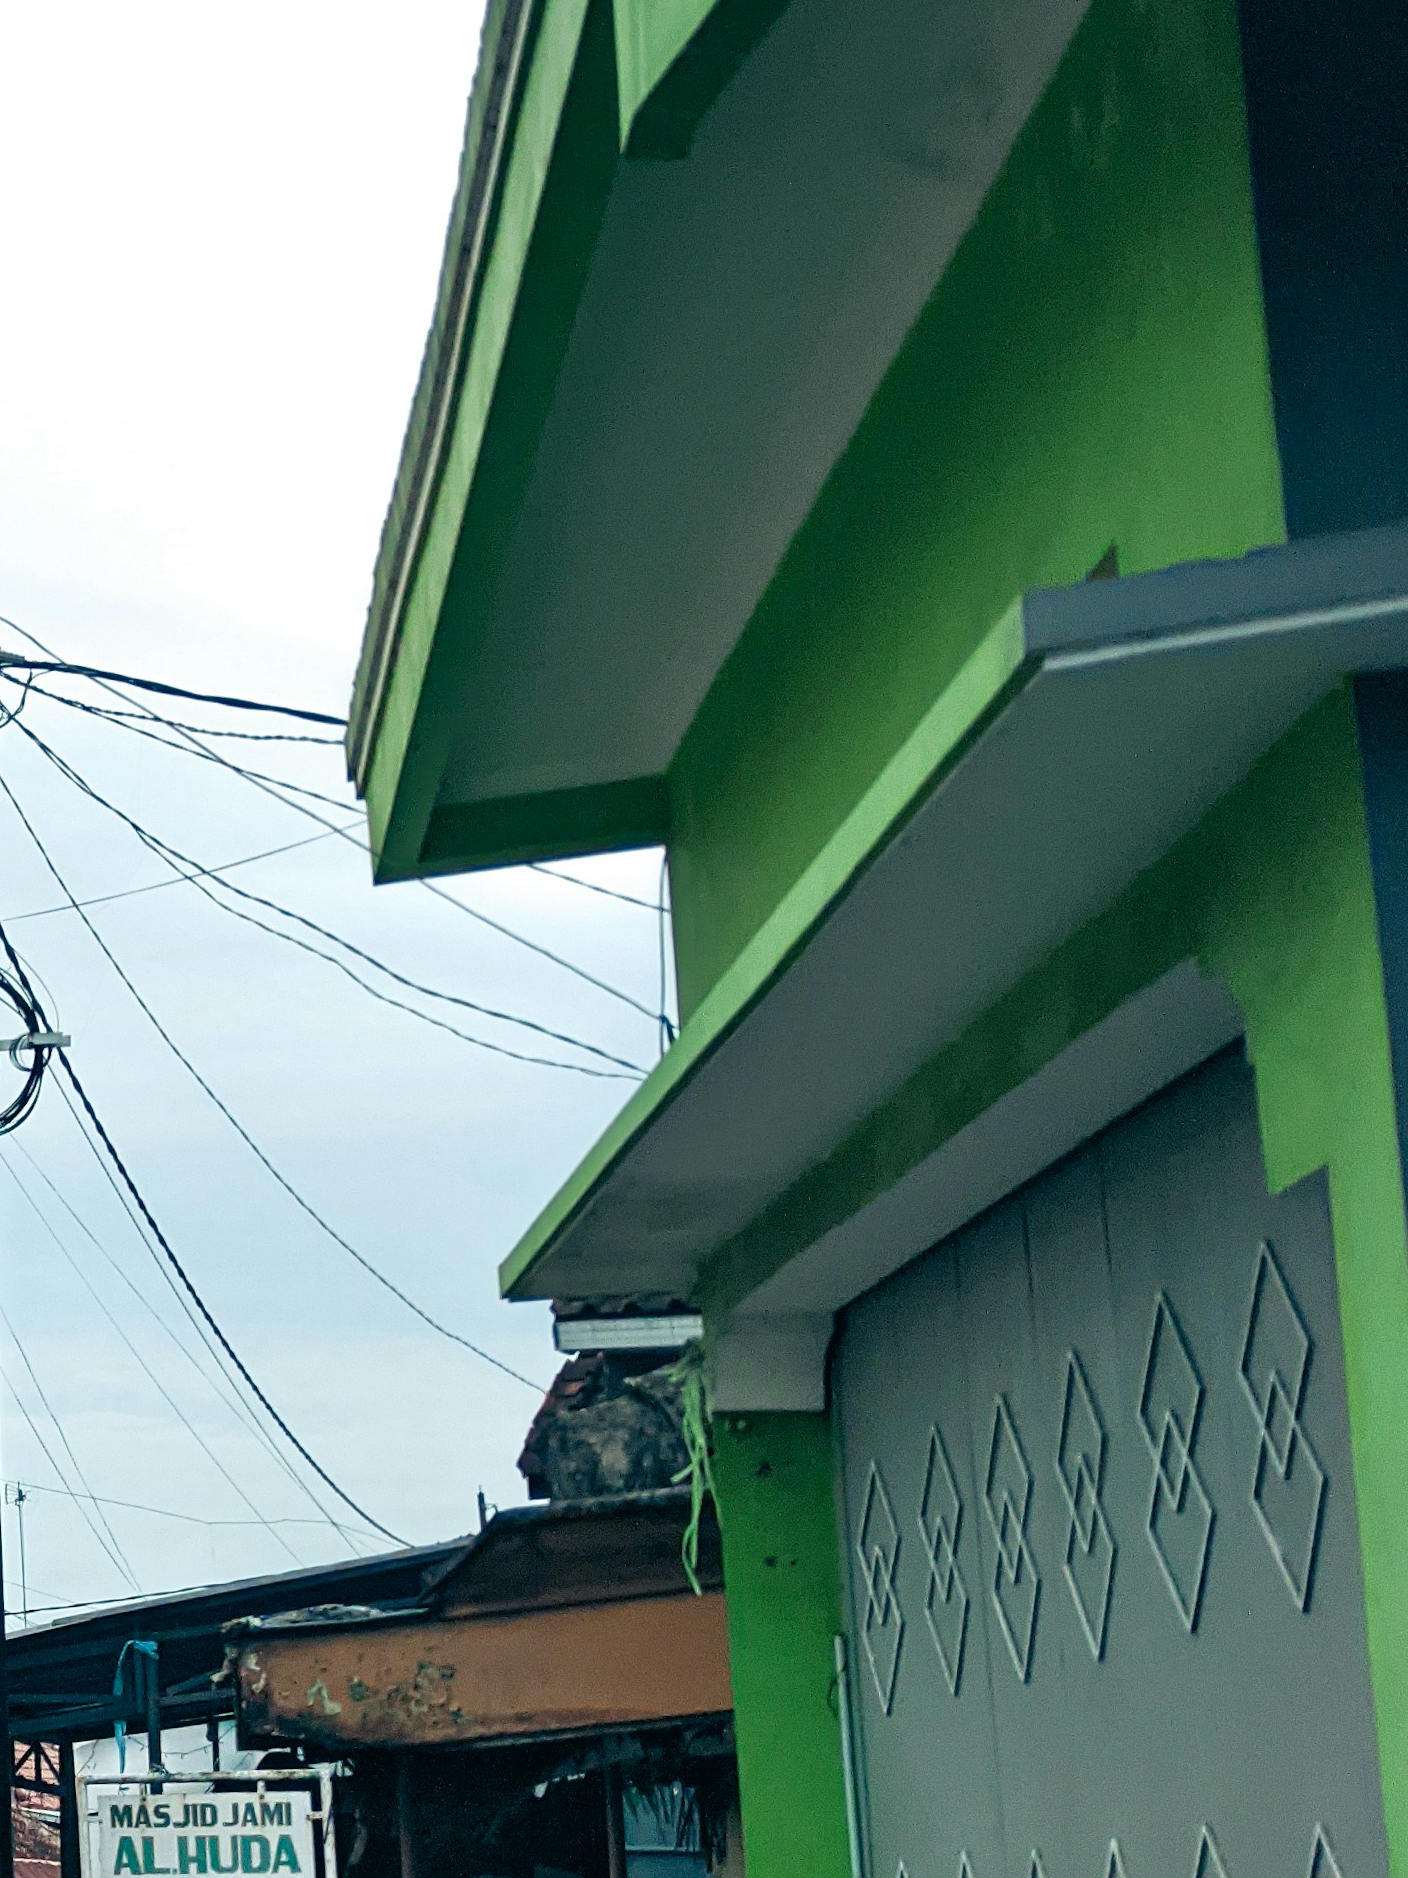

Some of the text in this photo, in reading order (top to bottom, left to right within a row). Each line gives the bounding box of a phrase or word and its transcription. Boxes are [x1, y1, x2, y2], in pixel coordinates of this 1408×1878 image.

[110, 1802, 292, 1829] MASJID JAMI
[113, 1834, 301, 1875] AL.HUDA
